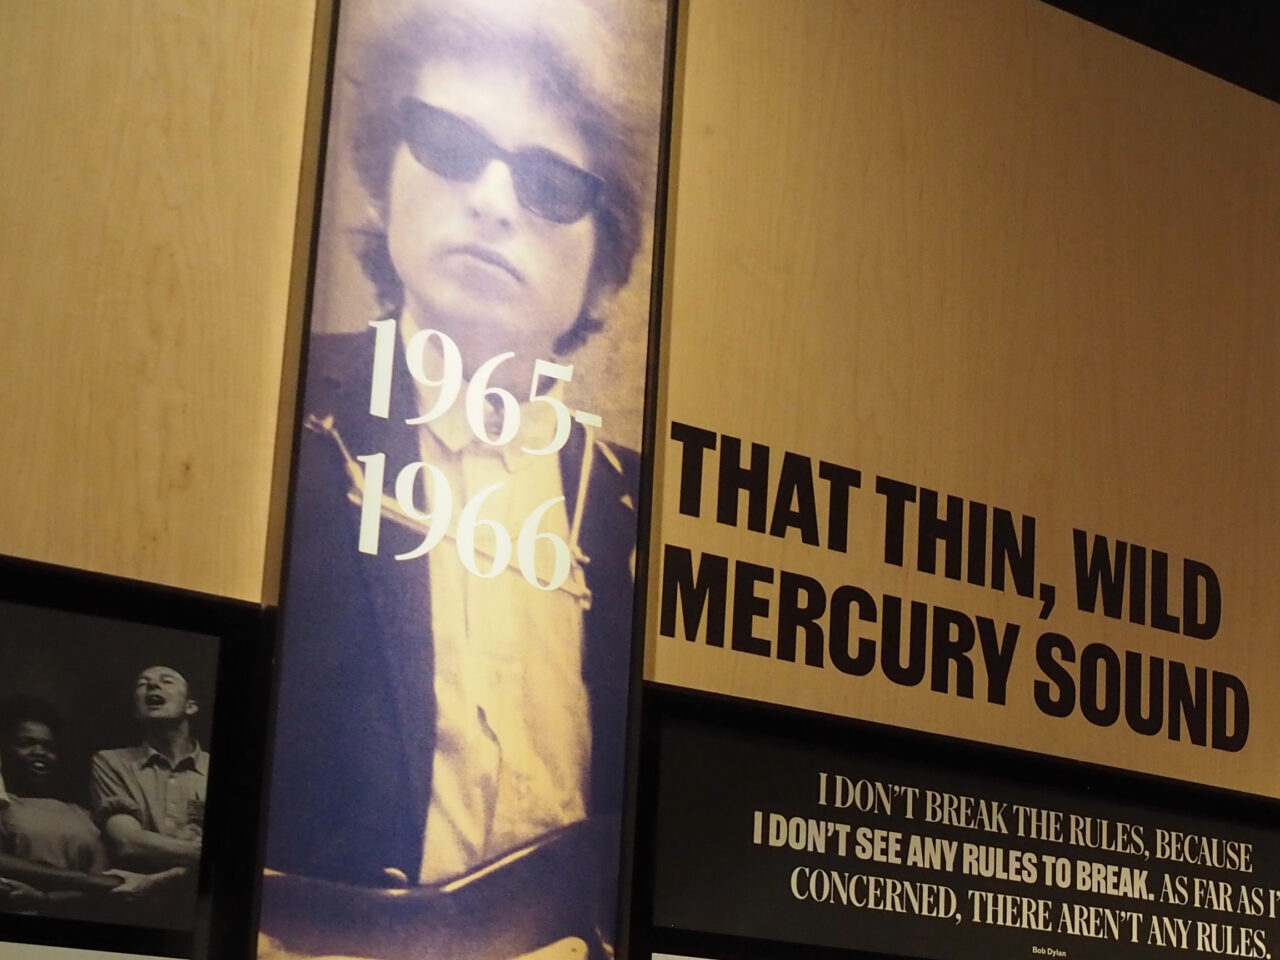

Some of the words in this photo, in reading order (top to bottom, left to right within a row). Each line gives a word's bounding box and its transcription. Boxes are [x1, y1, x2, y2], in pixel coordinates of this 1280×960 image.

[368, 318, 603, 455] 1965-
[357, 452, 571, 591] 1966
[671, 421, 861, 554] THAT
[875, 475, 1056, 621] THIN,
[1073, 528, 1222, 641] WILD
[659, 543, 1021, 706] MERCURY
[1033, 631, 1250, 753] SOUND
[753, 810, 762, 844] I
[768, 813, 850, 856] DON'T
[855, 827, 901, 864] SEE
[906, 834, 957, 871] ANY
[963, 842, 1036, 883] RULES
[1042, 855, 1070, 888] TO
[1076, 860, 1154, 900] BREAK.
[1160, 873, 1187, 905] AS
[1193, 877, 1232, 912] FAR
[1236, 885, 1263, 916] AS
[818, 772, 827, 805] I
[834, 775, 918, 818] DON'T
[925, 790, 1007, 833] BREAK
[1013, 805, 1062, 842] THE
[1069, 814, 1149, 860] RULES,
[1155, 828, 1252, 872] BECAUSE
[790, 866, 961, 923] CONCERNED,
[968, 890, 1051, 931] THERE
[1057, 902, 1142, 942] AREN'T
[1147, 915, 1191, 948] ANY
[1196, 921, 1271, 959] RULES.
[1032, 946, 1046, 955] Bob
[1047, 947, 1067, 957] Dylan
